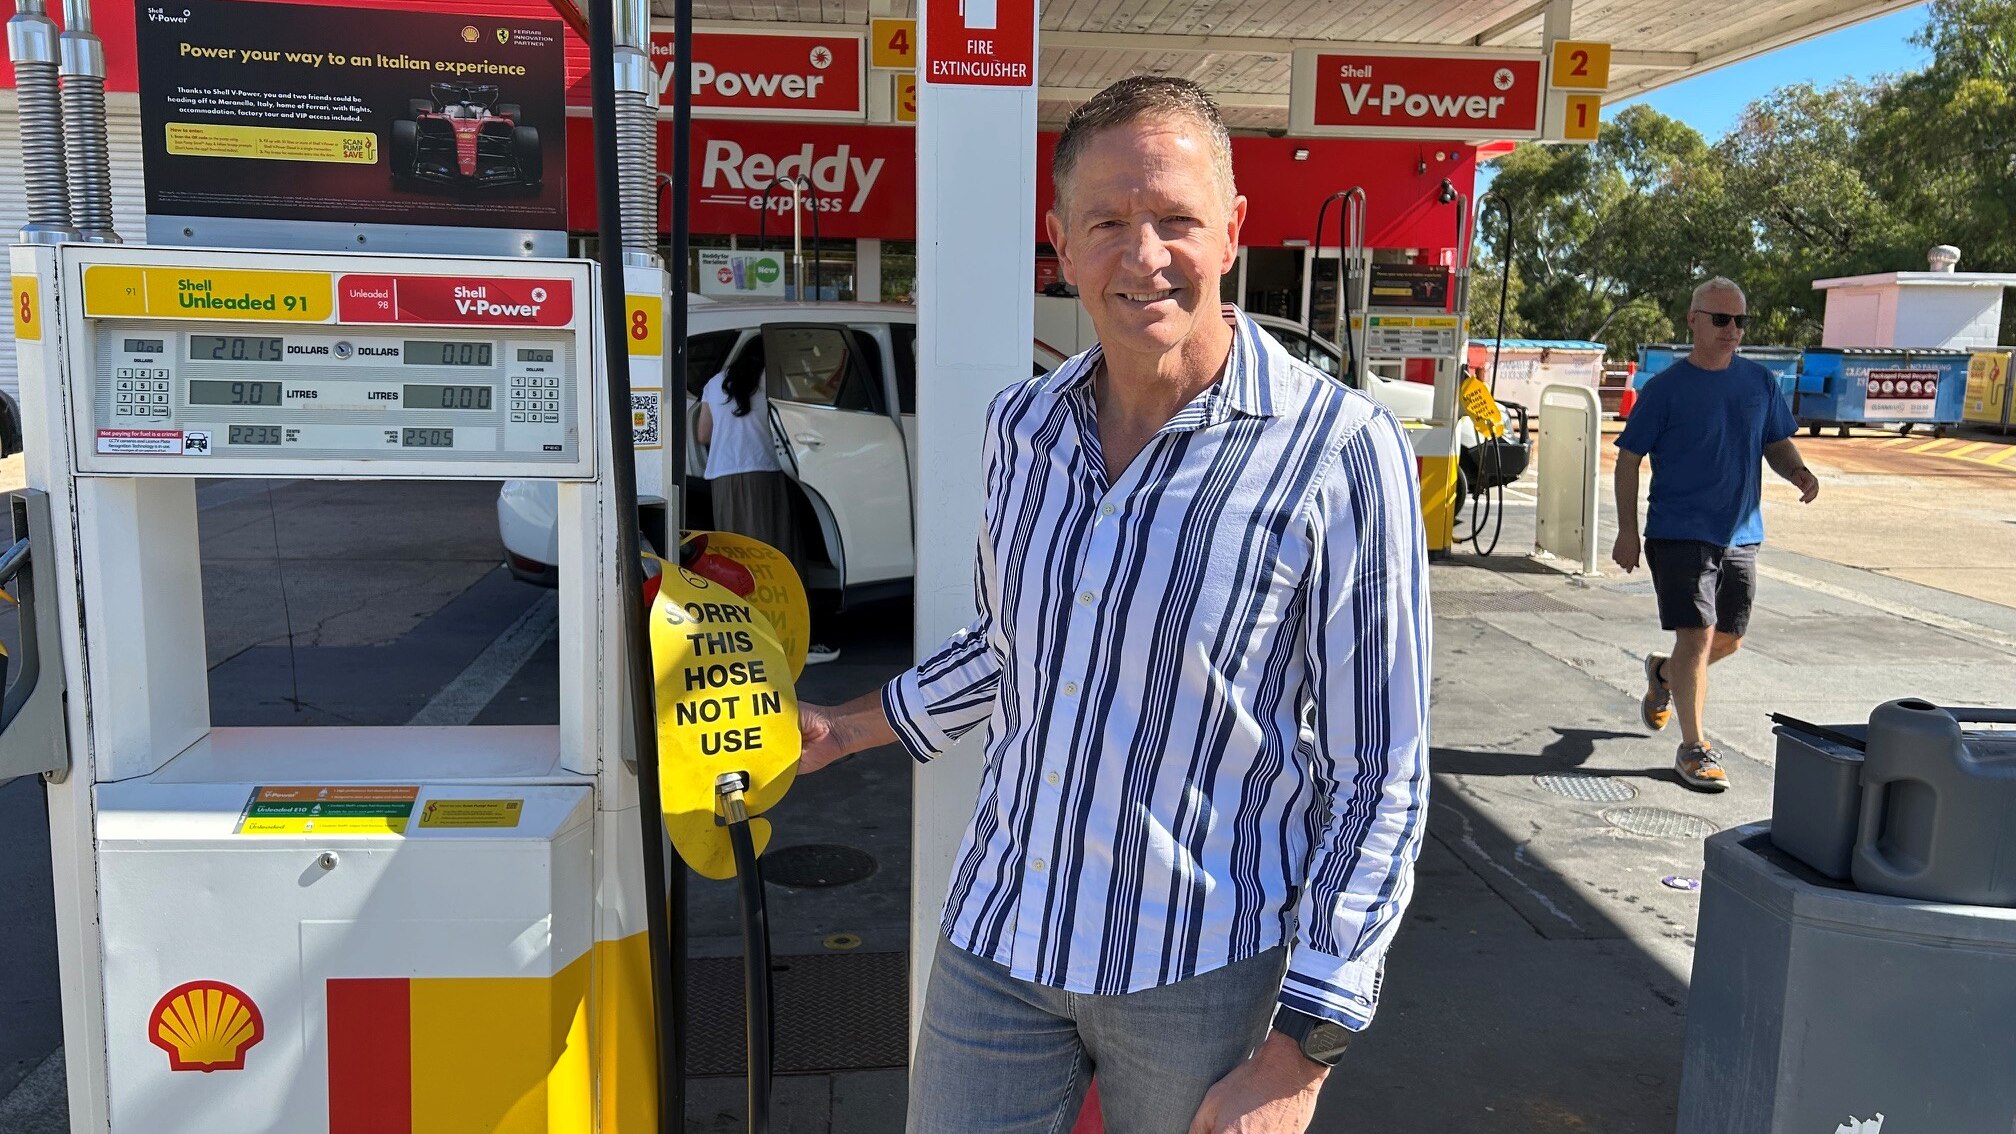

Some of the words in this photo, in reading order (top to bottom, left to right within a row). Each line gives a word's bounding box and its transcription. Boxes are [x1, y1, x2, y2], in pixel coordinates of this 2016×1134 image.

[148, 14, 188, 23] V-Power
[651, 42, 675, 55] hell
[888, 29, 909, 56] 4
[967, 39, 994, 55] FIRE
[180, 42, 236, 59] Power
[240, 49, 281, 64] your
[285, 52, 324, 68] way
[327, 52, 346, 66] to
[350, 55, 372, 67] an
[376, 53, 431, 71] Italian
[434, 60, 526, 76] experience
[1569, 50, 1589, 76] 2
[933, 60, 1027, 78] EXTINGUISHER
[1340, 64, 1373, 78] Shell
[650, 61, 824, 99] VPower
[177, 86, 202, 94] Thanks
[231, 89, 262, 98] V-Power,
[308, 93, 332, 101] friends
[1340, 83, 1505, 120] V-Power
[167, 95, 196, 105] heading
[218, 98, 256, 107] Maranello,
[257, 101, 275, 109] Italy,
[276, 101, 296, 109] home
[305, 103, 331, 111] Ferrari,
[349, 105, 372, 114] flights,
[178, 107, 237, 116] accommodation,
[237, 109, 263, 118] factory
[331, 114, 363, 122] included.
[1576, 103, 1587, 128] 1
[343, 138, 363, 146] SCAN
[701, 139, 886, 213] Reddy
[748, 195, 843, 216] express
[757, 265, 777, 274] New
[125, 286, 137, 296] 91
[178, 279, 212, 291] Shell
[350, 289, 389, 298] Unleaded
[454, 286, 486, 298] Shell
[20, 291, 32, 324] 8
[178, 291, 276, 311] Unleaded
[283, 295, 307, 312] 91
[377, 301, 389, 309] 98
[454, 299, 541, 317] V-Power
[631, 309, 649, 341] 8
[212, 337, 282, 361] 20.15
[287, 345, 329, 355] DOLLARS
[358, 347, 399, 356] DOLLARS
[442, 343, 490, 365] 0.00
[1870, 372, 1898, 380] Packaged
[1911, 373, 1938, 381] Recycling
[140, 382, 145, 390] 5
[231, 382, 282, 405] 9.01
[286, 389, 318, 399] LITRES
[368, 391, 399, 400] LITRES
[442, 387, 490, 409] 0.00
[231, 427, 280, 444] 223.5
[405, 430, 452, 446] 250.5
[665, 602, 752, 625] SORRY
[686, 631, 753, 657] THIS
[684, 660, 768, 691] HOSE
[675, 696, 740, 726] NOT
[752, 690, 782, 717] IN
[700, 726, 763, 756] USE
